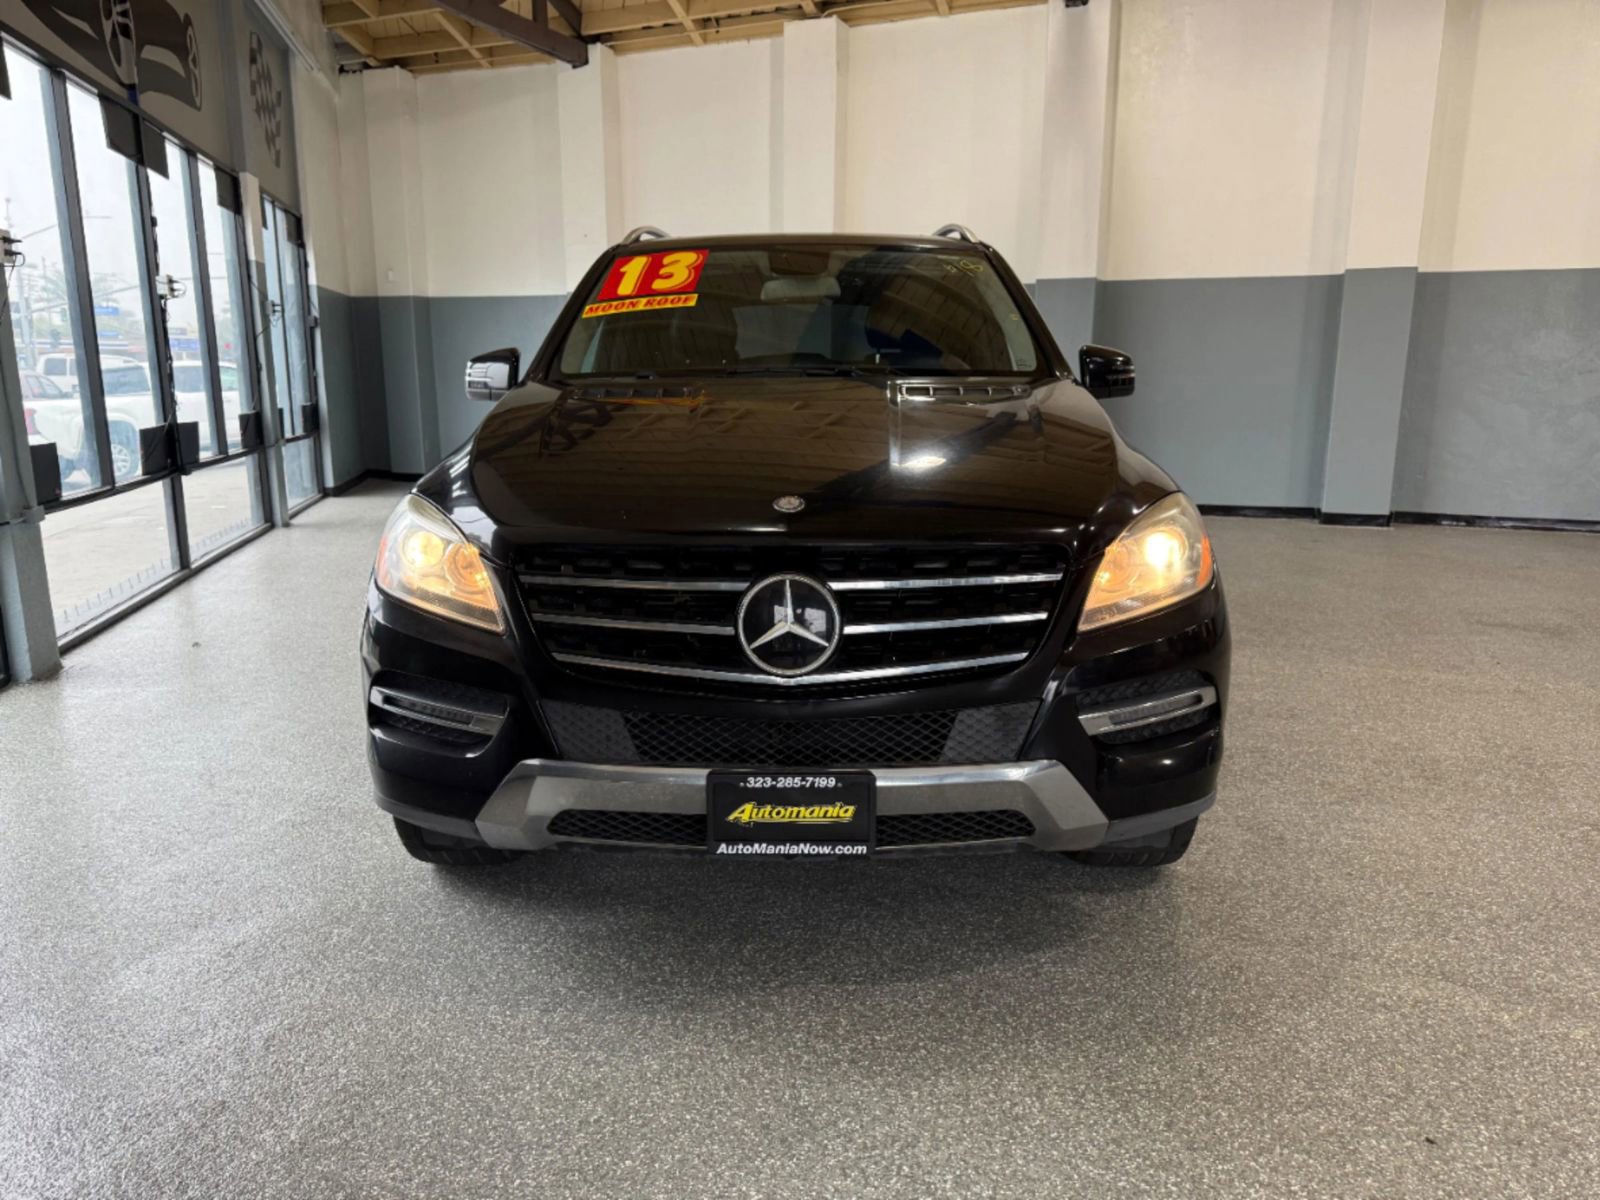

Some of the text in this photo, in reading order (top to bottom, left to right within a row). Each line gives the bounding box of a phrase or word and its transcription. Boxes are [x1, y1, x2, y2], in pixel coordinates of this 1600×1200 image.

[617, 251, 703, 296] 13
[584, 300, 640, 316] MOON
[746, 776, 836, 788] 323-285-7199
[726, 801, 857, 824] Automania
[716, 842, 867, 855] AutoManiaNow.com
